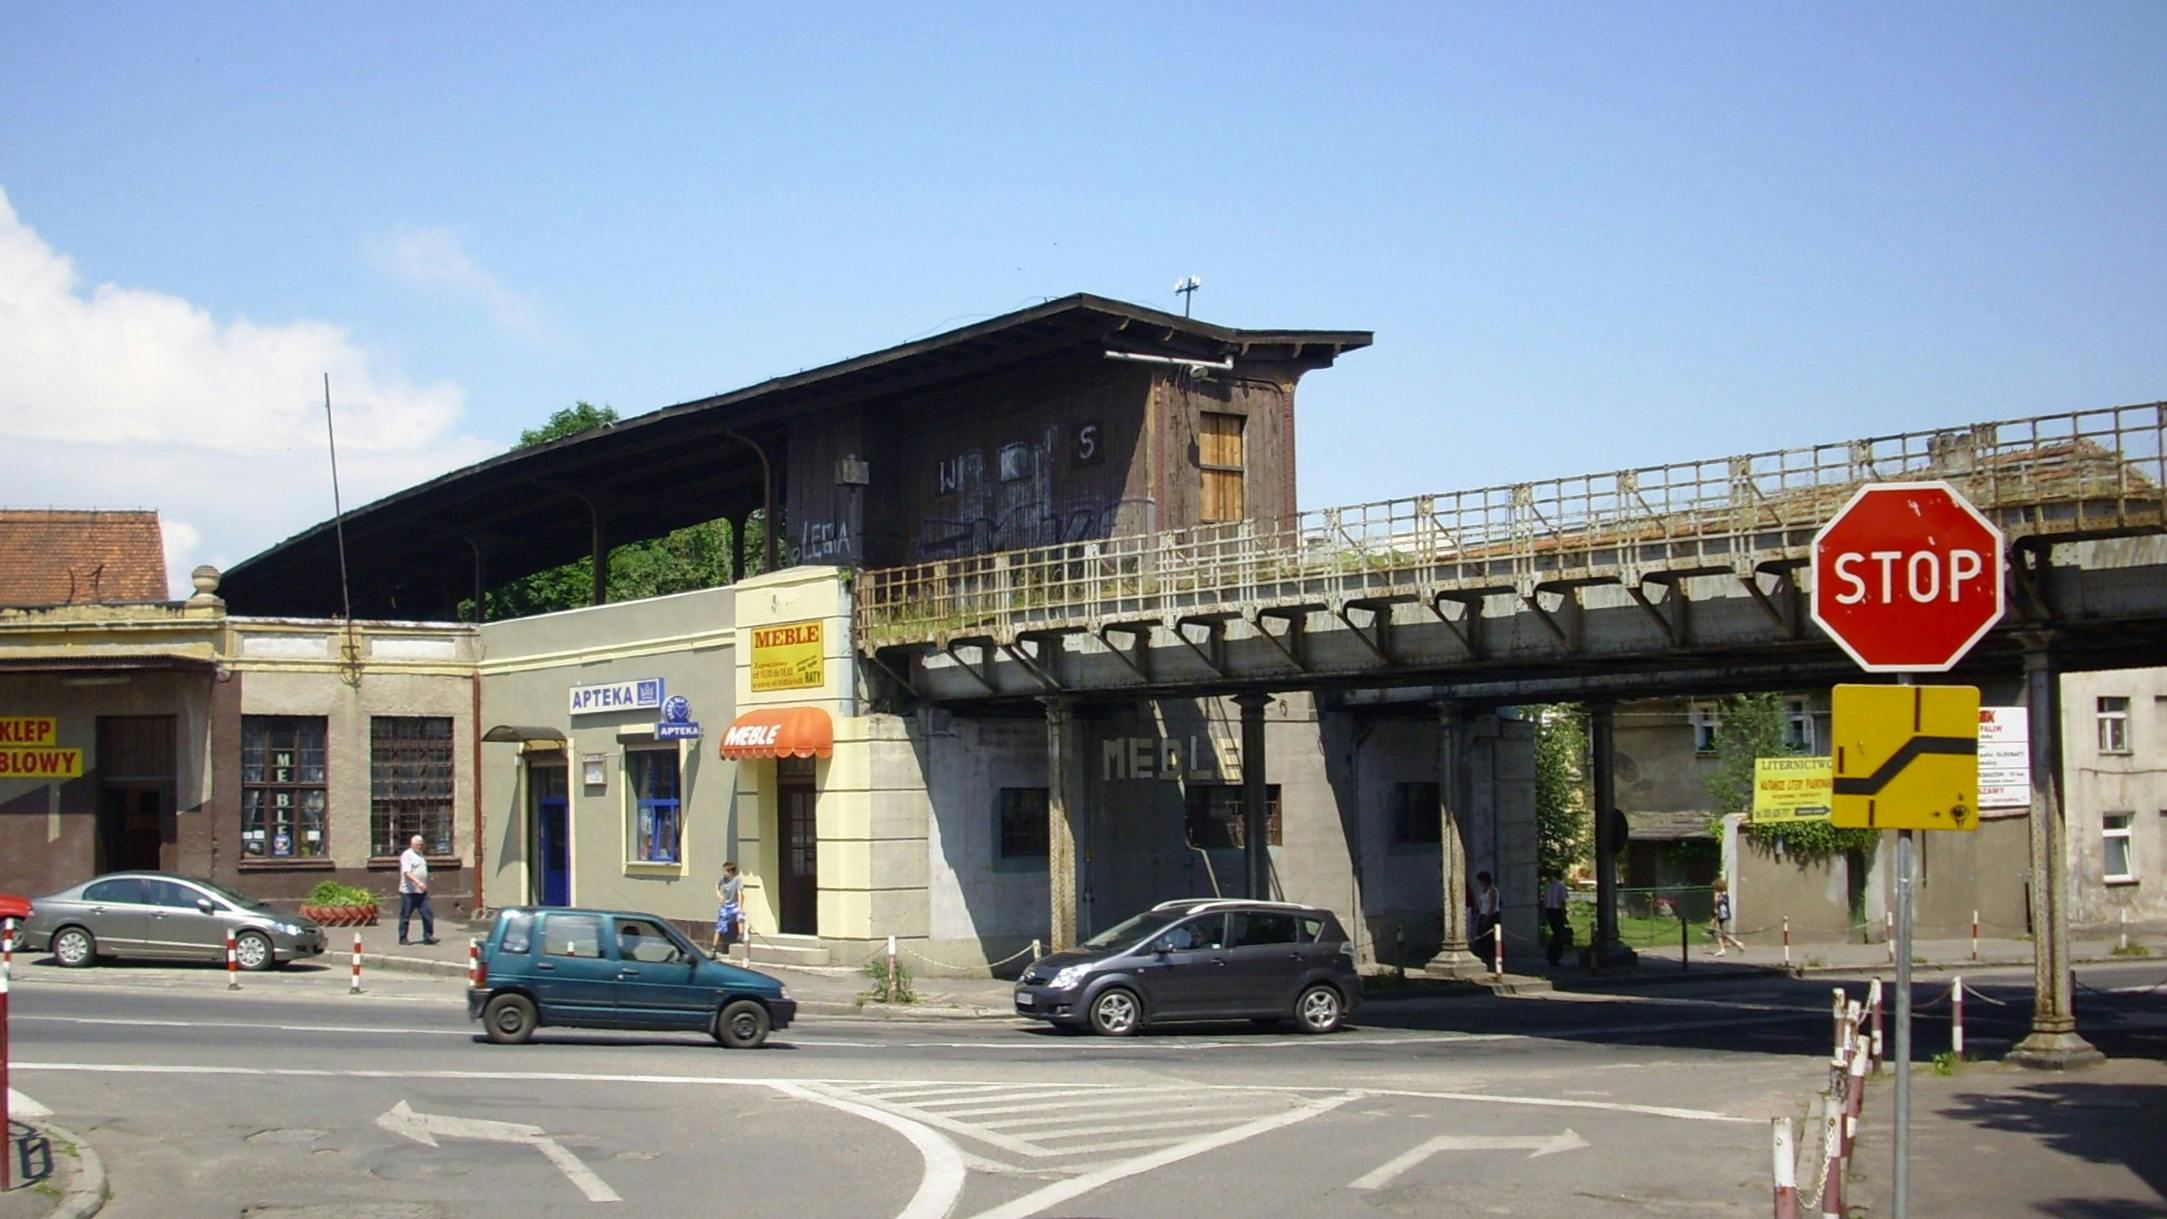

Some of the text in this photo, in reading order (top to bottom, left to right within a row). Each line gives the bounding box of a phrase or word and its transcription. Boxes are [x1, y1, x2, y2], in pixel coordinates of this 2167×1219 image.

[1834, 549, 1982, 605] STOP
[754, 625, 819, 648] MEBLE
[805, 671, 821, 683] RATY
[572, 686, 633, 710] APTEKA
[0, 720, 51, 741] KLEP
[660, 726, 699, 736] APTEKA
[724, 724, 781, 746] MEBLE
[0, 752, 76, 773] BLOWY
